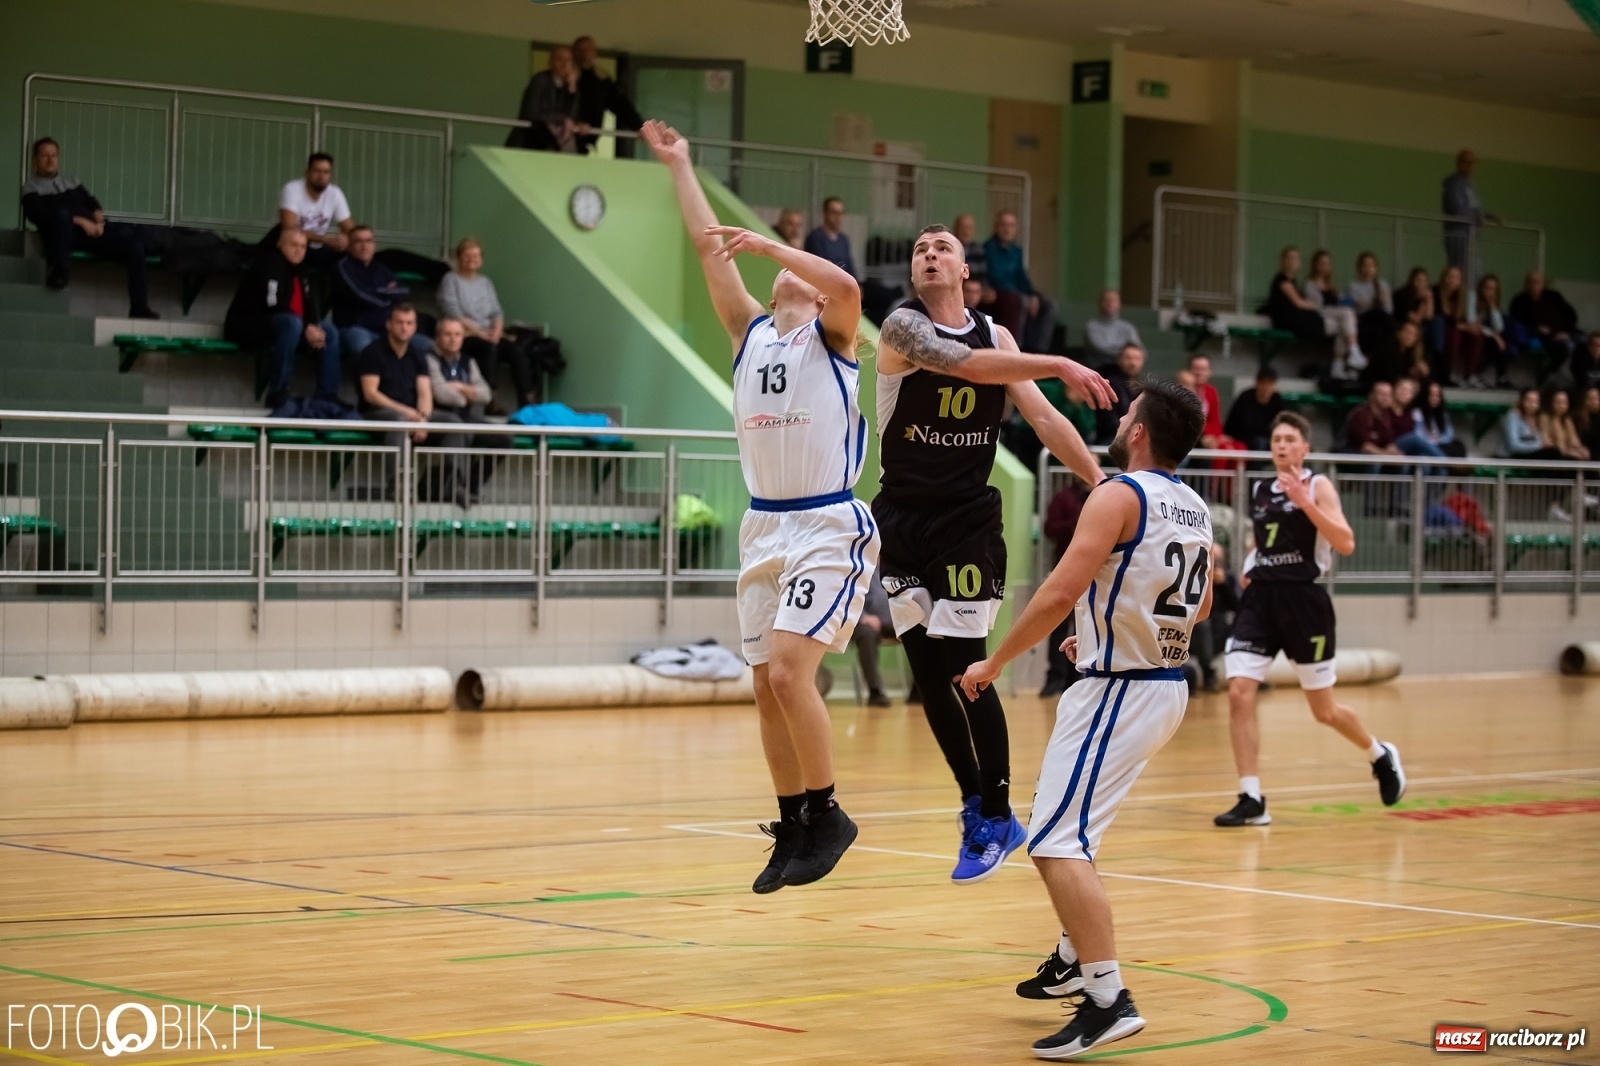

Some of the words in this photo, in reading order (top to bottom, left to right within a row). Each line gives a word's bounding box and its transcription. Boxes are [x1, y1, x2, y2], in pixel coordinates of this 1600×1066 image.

[819, 51, 842, 69] F
[1082, 77, 1102, 98] F
[757, 363, 787, 395] 13
[937, 386, 976, 420] 10
[758, 416, 801, 428] KAMIKA
[908, 423, 992, 447] Nacomi
[1264, 522, 1280, 549] 7
[786, 576, 816, 610] 13
[945, 563, 982, 599] 10
[1153, 541, 1209, 618] 24
[1158, 627, 1188, 644] FENS
[1310, 635, 1327, 662] 7
